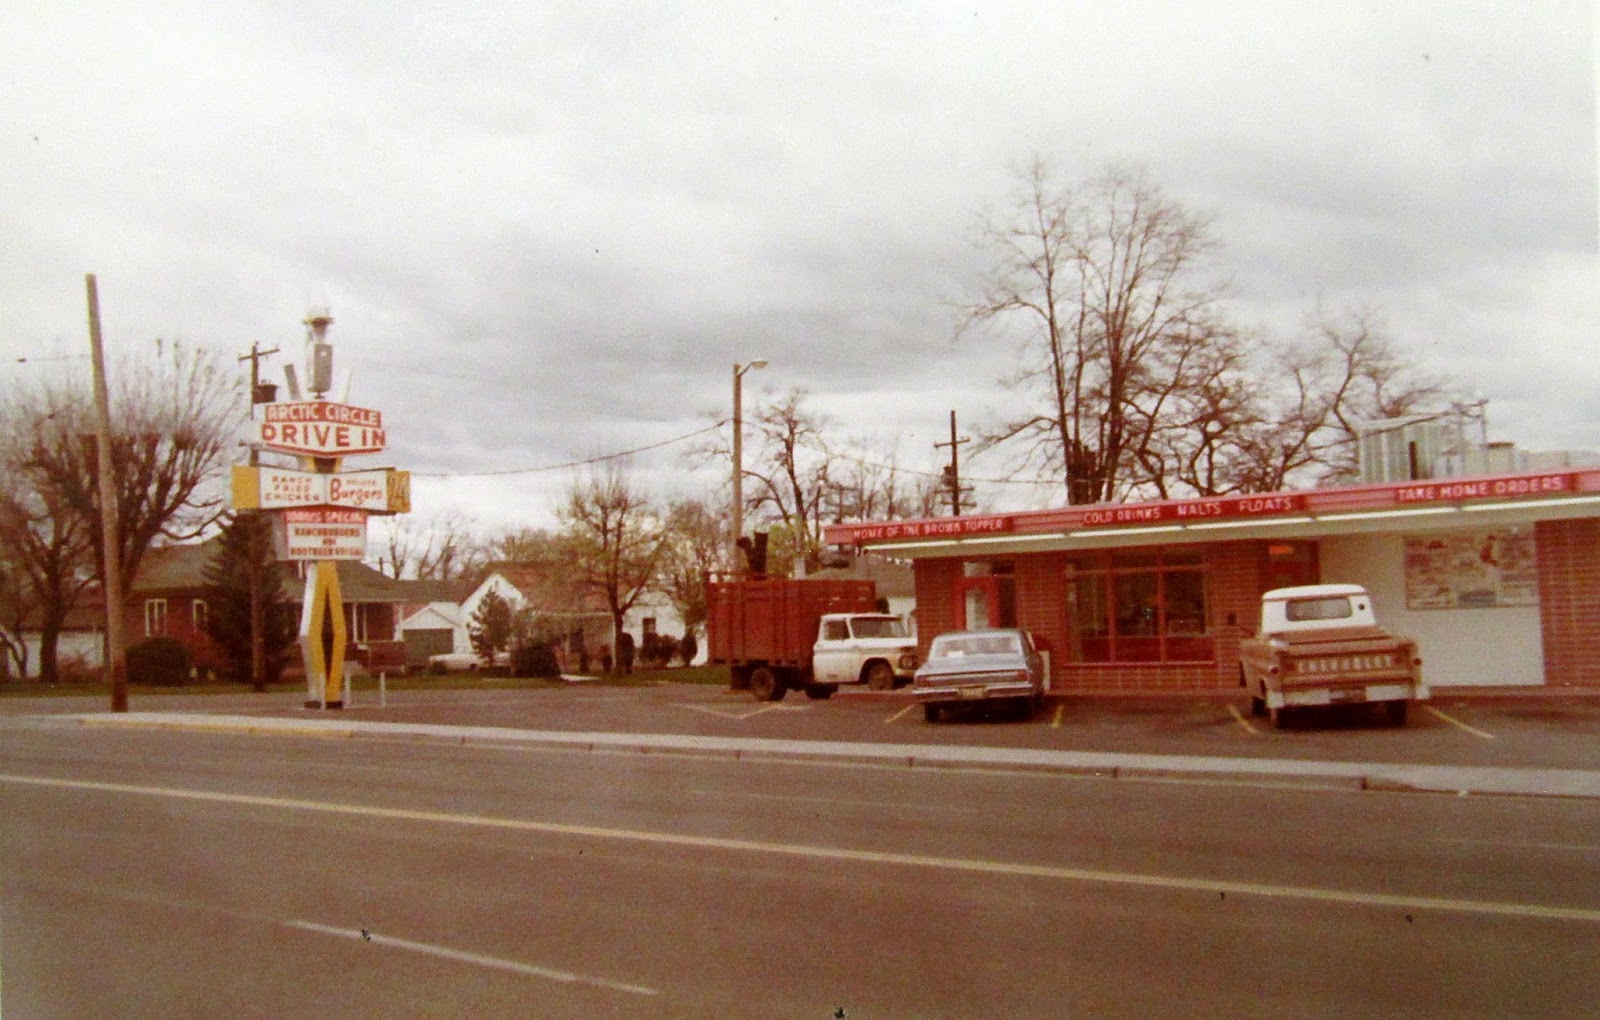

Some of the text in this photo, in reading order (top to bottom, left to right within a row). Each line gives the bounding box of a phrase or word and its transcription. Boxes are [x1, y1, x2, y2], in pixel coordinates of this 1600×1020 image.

[266, 403, 378, 424] ARCTIC CIRCLE
[261, 424, 386, 447] DRIVE IN
[264, 492, 320, 501] CHICKEN
[329, 477, 383, 505] Burgers
[1398, 476, 1564, 500] TAKE HOME ORDERS
[1083, 497, 1292, 524] COLD DRINKS MALTS FLOATS
[853, 519, 1004, 540] HOME OF THE BROWN TOPPER
